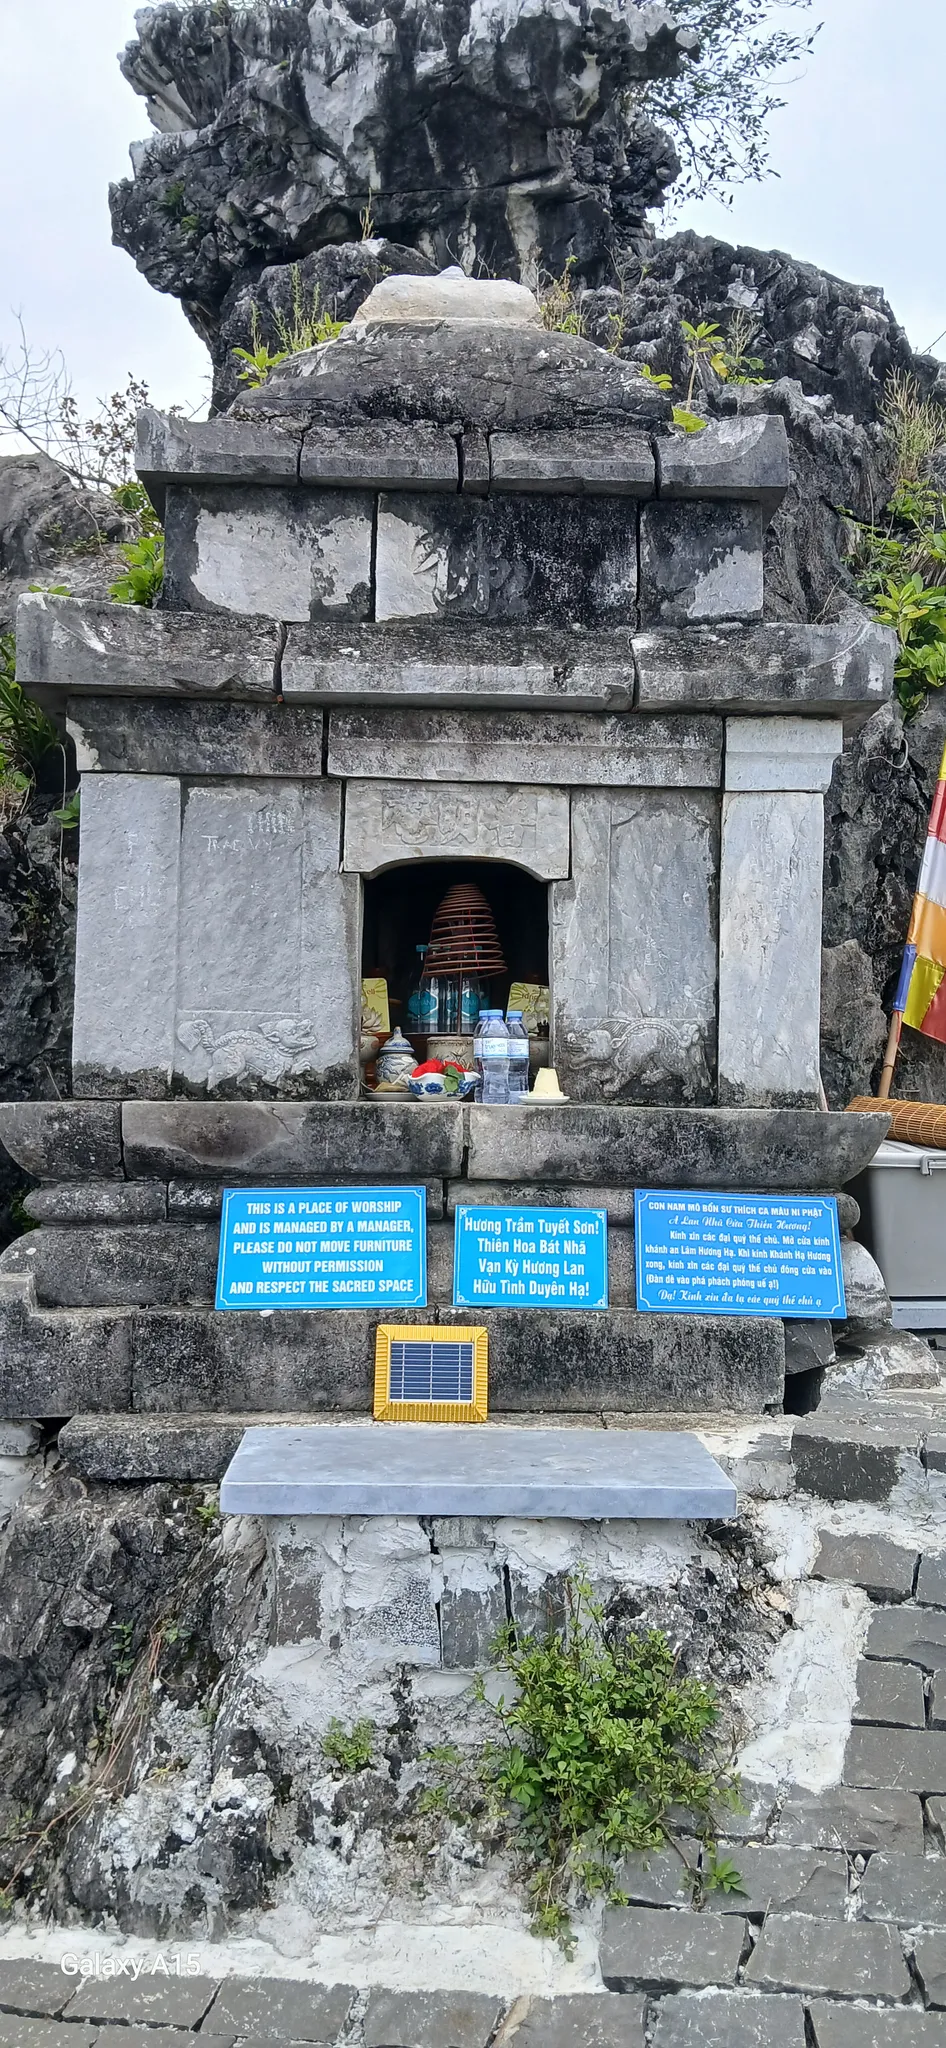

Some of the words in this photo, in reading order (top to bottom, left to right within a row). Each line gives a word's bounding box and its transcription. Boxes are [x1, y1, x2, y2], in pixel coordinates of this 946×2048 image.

[247, 1203, 270, 1215] THIS
[274, 1203, 284, 1214] IS
[288, 1203, 295, 1214] A
[299, 1202, 331, 1214] PLACE
[335, 1202, 348, 1213] OF
[352, 1201, 401, 1213] WORSHIP
[233, 1222, 256, 1234] AND
[260, 1222, 270, 1234] IS
[274, 1221, 327, 1234] MANAGED
[330, 1221, 344, 1232] BY
[347, 1221, 354, 1232] A
[357, 1220, 413, 1233] MANAGER,
[465, 1217, 501, 1233] Hương
[505, 1216, 534, 1233] Trầm
[538, 1218, 570, 1236] Tuyết
[574, 1220, 599, 1234] Sơn!
[234, 1242, 274, 1254] PLEASE
[278, 1241, 292, 1253] DO
[296, 1241, 317, 1253] NOT
[320, 1241, 350, 1252] MOVE
[353, 1240, 412, 1252] FURNITURE
[478, 1238, 509, 1252] Thiên
[513, 1239, 536, 1253] Hoa
[540, 1240, 560, 1254] Bát
[564, 1240, 586, 1254] Nhã
[262, 1261, 311, 1273] WITHOUT
[314, 1260, 383, 1272] PERMISSION
[478, 1258, 500, 1276] Vạn
[505, 1259, 519, 1276] Kỳ
[523, 1260, 559, 1277] Hương
[564, 1261, 584, 1275] Lan
[230, 1282, 253, 1294] AND
[256, 1281, 305, 1294] RESPECT
[309, 1281, 329, 1292] THE
[332, 1280, 375, 1292] SACRED
[378, 1280, 413, 1292] SPACE
[473, 1279, 496, 1293] Hữu
[501, 1279, 525, 1294] Tình
[529, 1280, 565, 1298] Duyên
[569, 1282, 589, 1299] Hạ!
